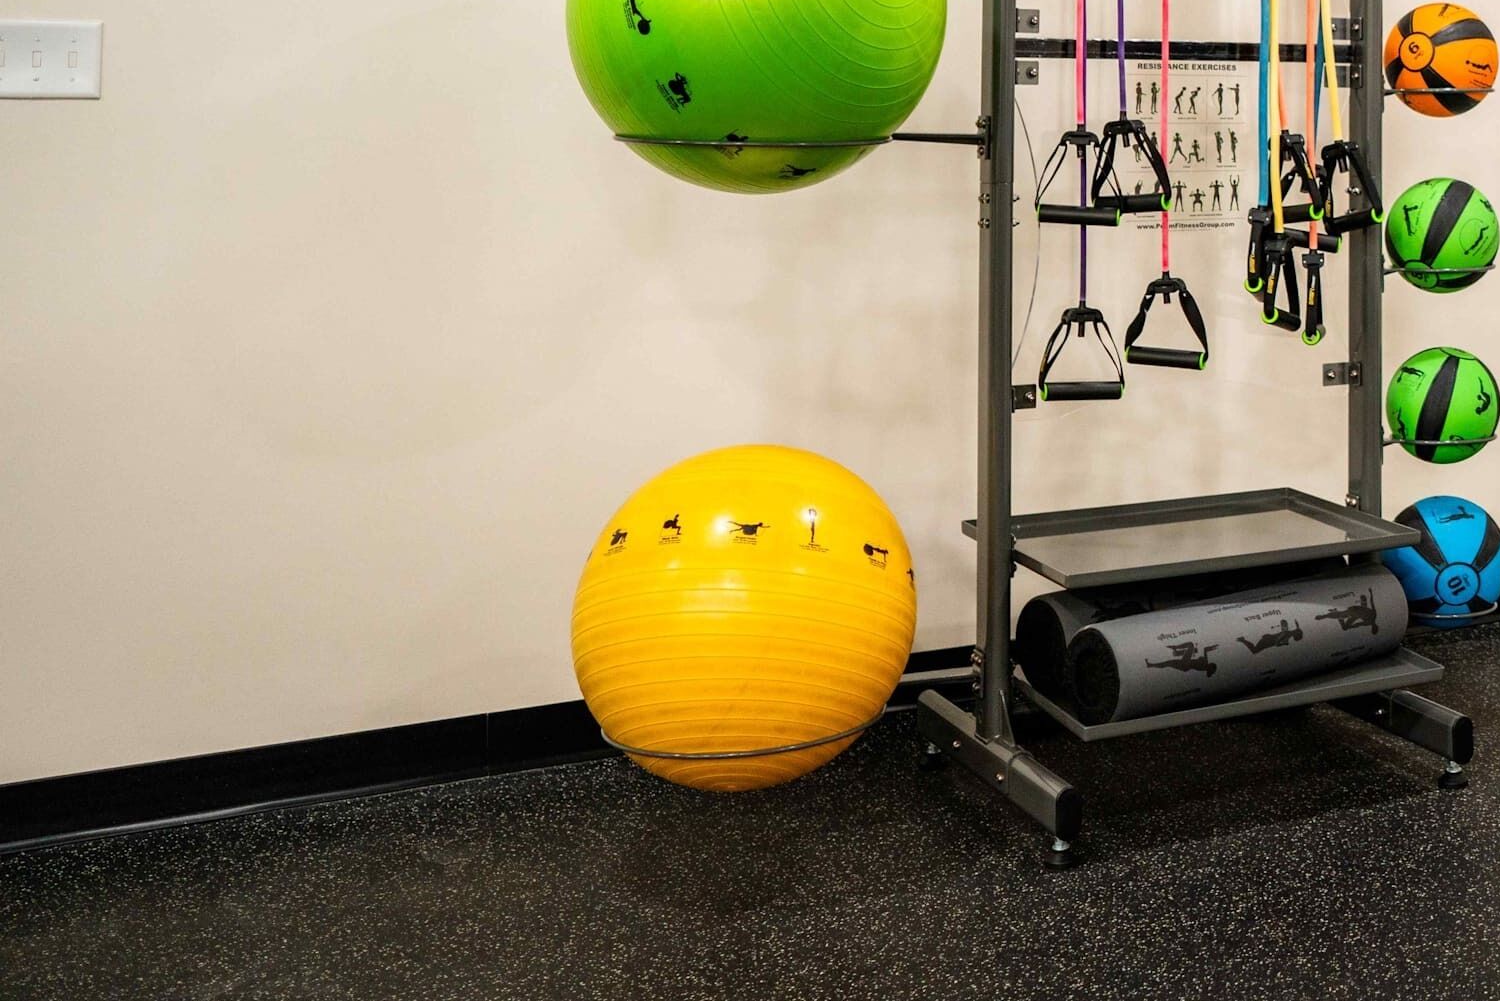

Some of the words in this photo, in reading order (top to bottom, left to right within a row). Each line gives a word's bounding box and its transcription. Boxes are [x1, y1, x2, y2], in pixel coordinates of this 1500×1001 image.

[1408, 41, 1420, 54] 6
[1137, 63, 1189, 71] RESISANCE
[1191, 64, 1237, 72] EXERCISES
[1447, 577, 1467, 597] 10
[1243, 613, 1260, 623] Back
[1261, 608, 1282, 619] Upper
[1156, 631, 1177, 642] Thigh
[1178, 627, 1197, 637] Inner
